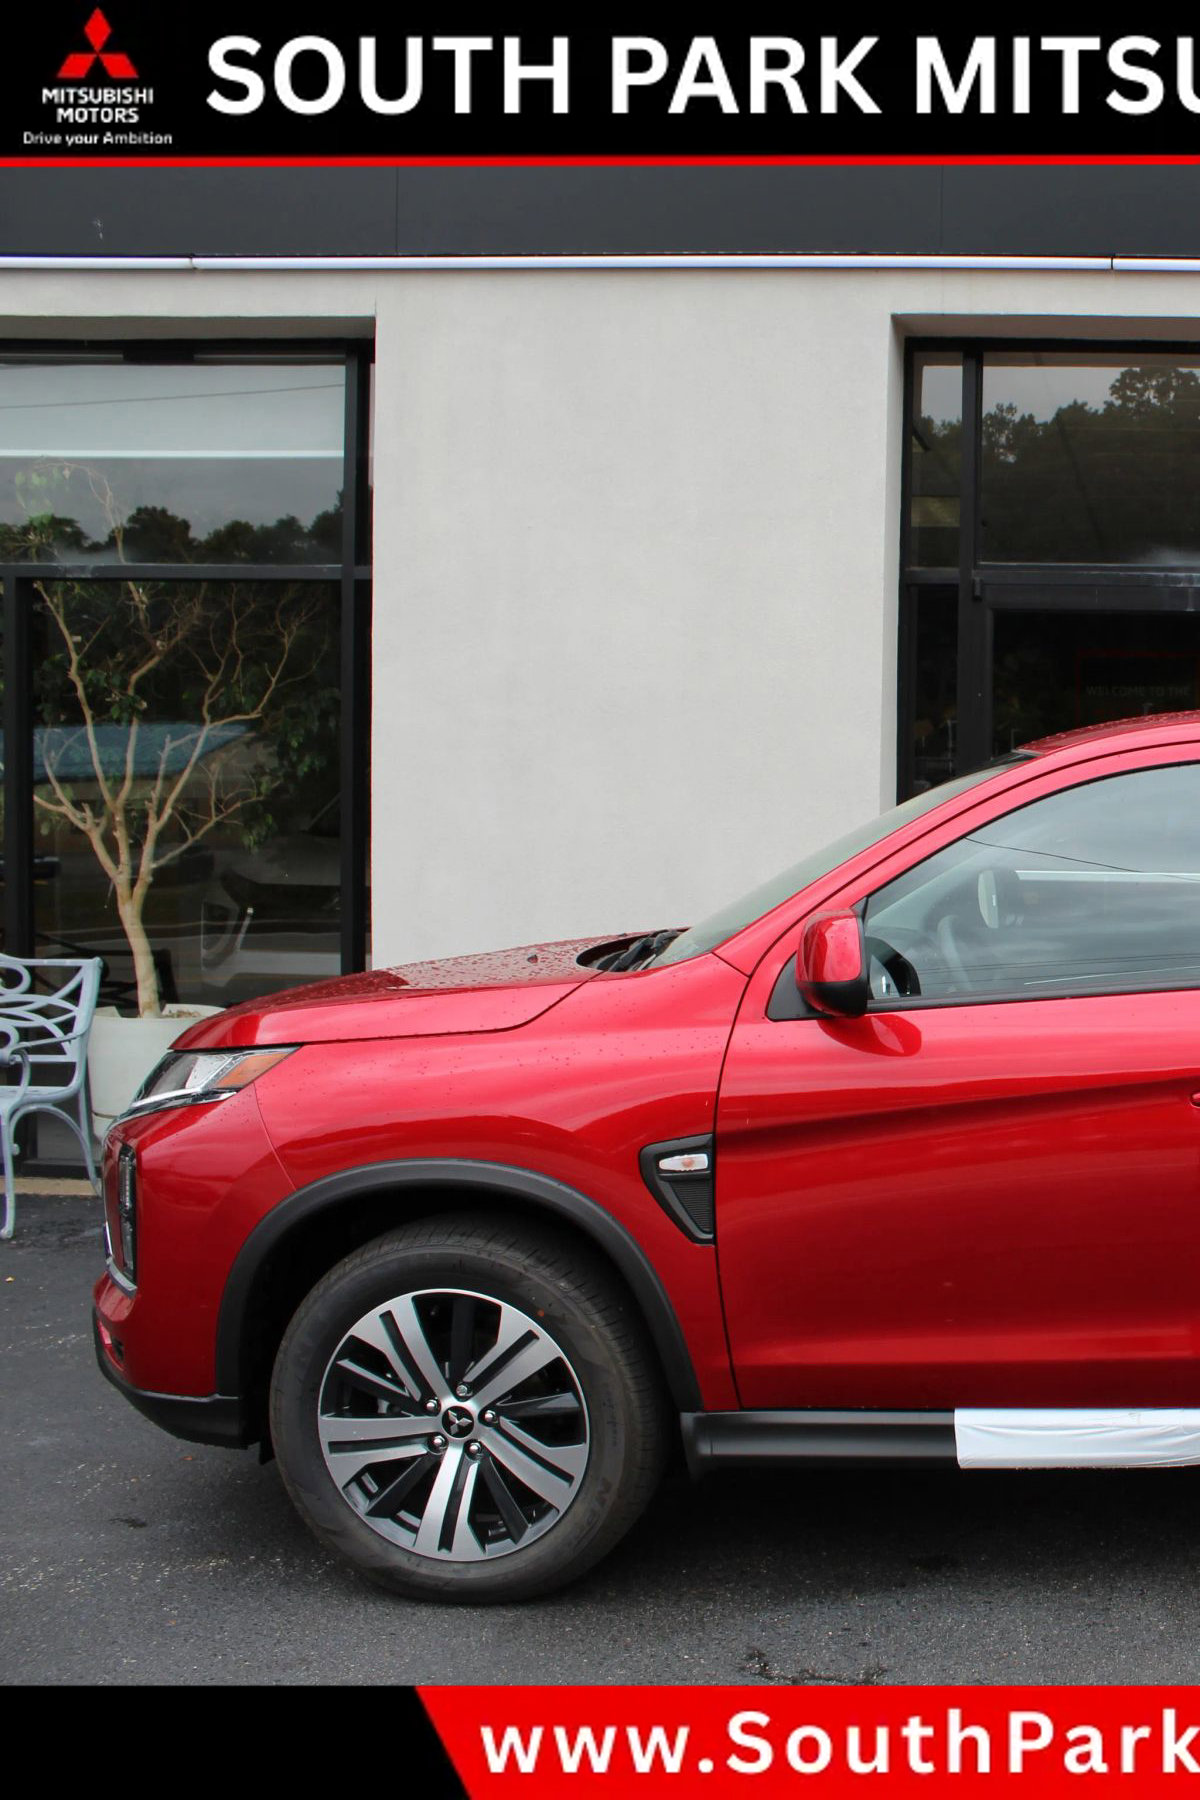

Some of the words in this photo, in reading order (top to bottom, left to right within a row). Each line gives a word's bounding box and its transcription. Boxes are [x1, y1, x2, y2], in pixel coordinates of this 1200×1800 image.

[1086, 685, 1145, 697] WELCOME
[1150, 685, 1165, 697] TO
[1167, 684, 1191, 697] THE
